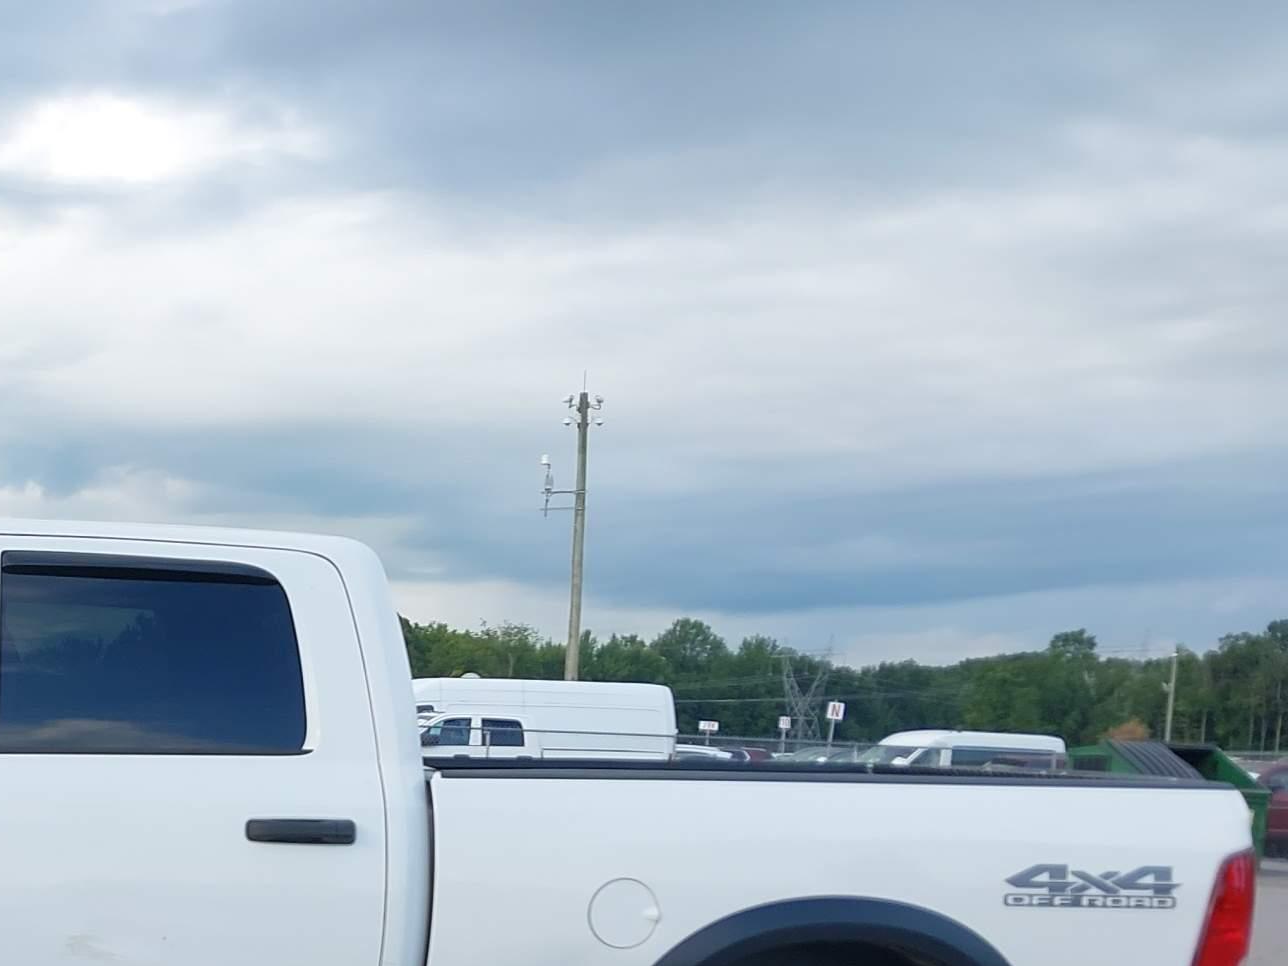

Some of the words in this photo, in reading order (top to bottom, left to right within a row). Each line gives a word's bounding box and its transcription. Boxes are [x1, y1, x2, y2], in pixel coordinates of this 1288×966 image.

[831, 703, 841, 717] N
[1006, 894, 1072, 907] OFF
[1080, 895, 1176, 908] ROAD
